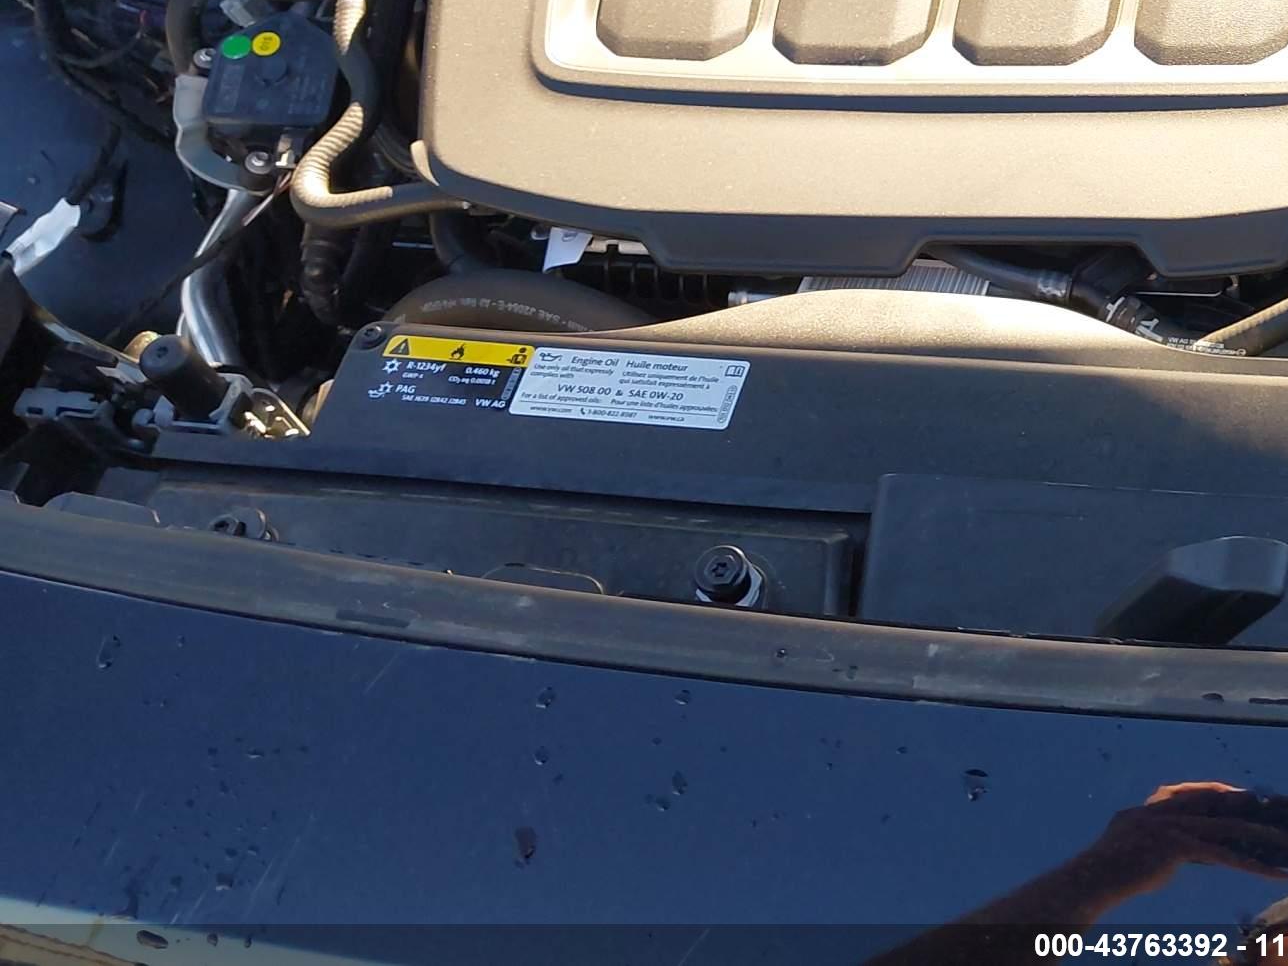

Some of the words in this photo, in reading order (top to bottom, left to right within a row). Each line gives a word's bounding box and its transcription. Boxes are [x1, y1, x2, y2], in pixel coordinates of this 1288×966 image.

[571, 355, 603, 367] Engine
[604, 358, 620, 366] Oil
[626, 359, 652, 369] Huile
[652, 362, 688, 371] moteur
[406, 361, 447, 373] R-1234yf
[584, 367, 614, 376] expressly
[489, 368, 500, 378] kg
[395, 384, 416, 394] PAG
[557, 384, 576, 393] VW
[576, 385, 596, 394] 508
[596, 387, 612, 396] 00
[628, 389, 647, 398] SAE
[648, 391, 684, 401] 0W-20
[537, 392, 549, 400] list
[556, 395, 588, 403] approved
[610, 398, 627, 406] Pour
[640, 400, 654, 408] liste
[475, 398, 492, 407] VW
[492, 400, 506, 409] AG
